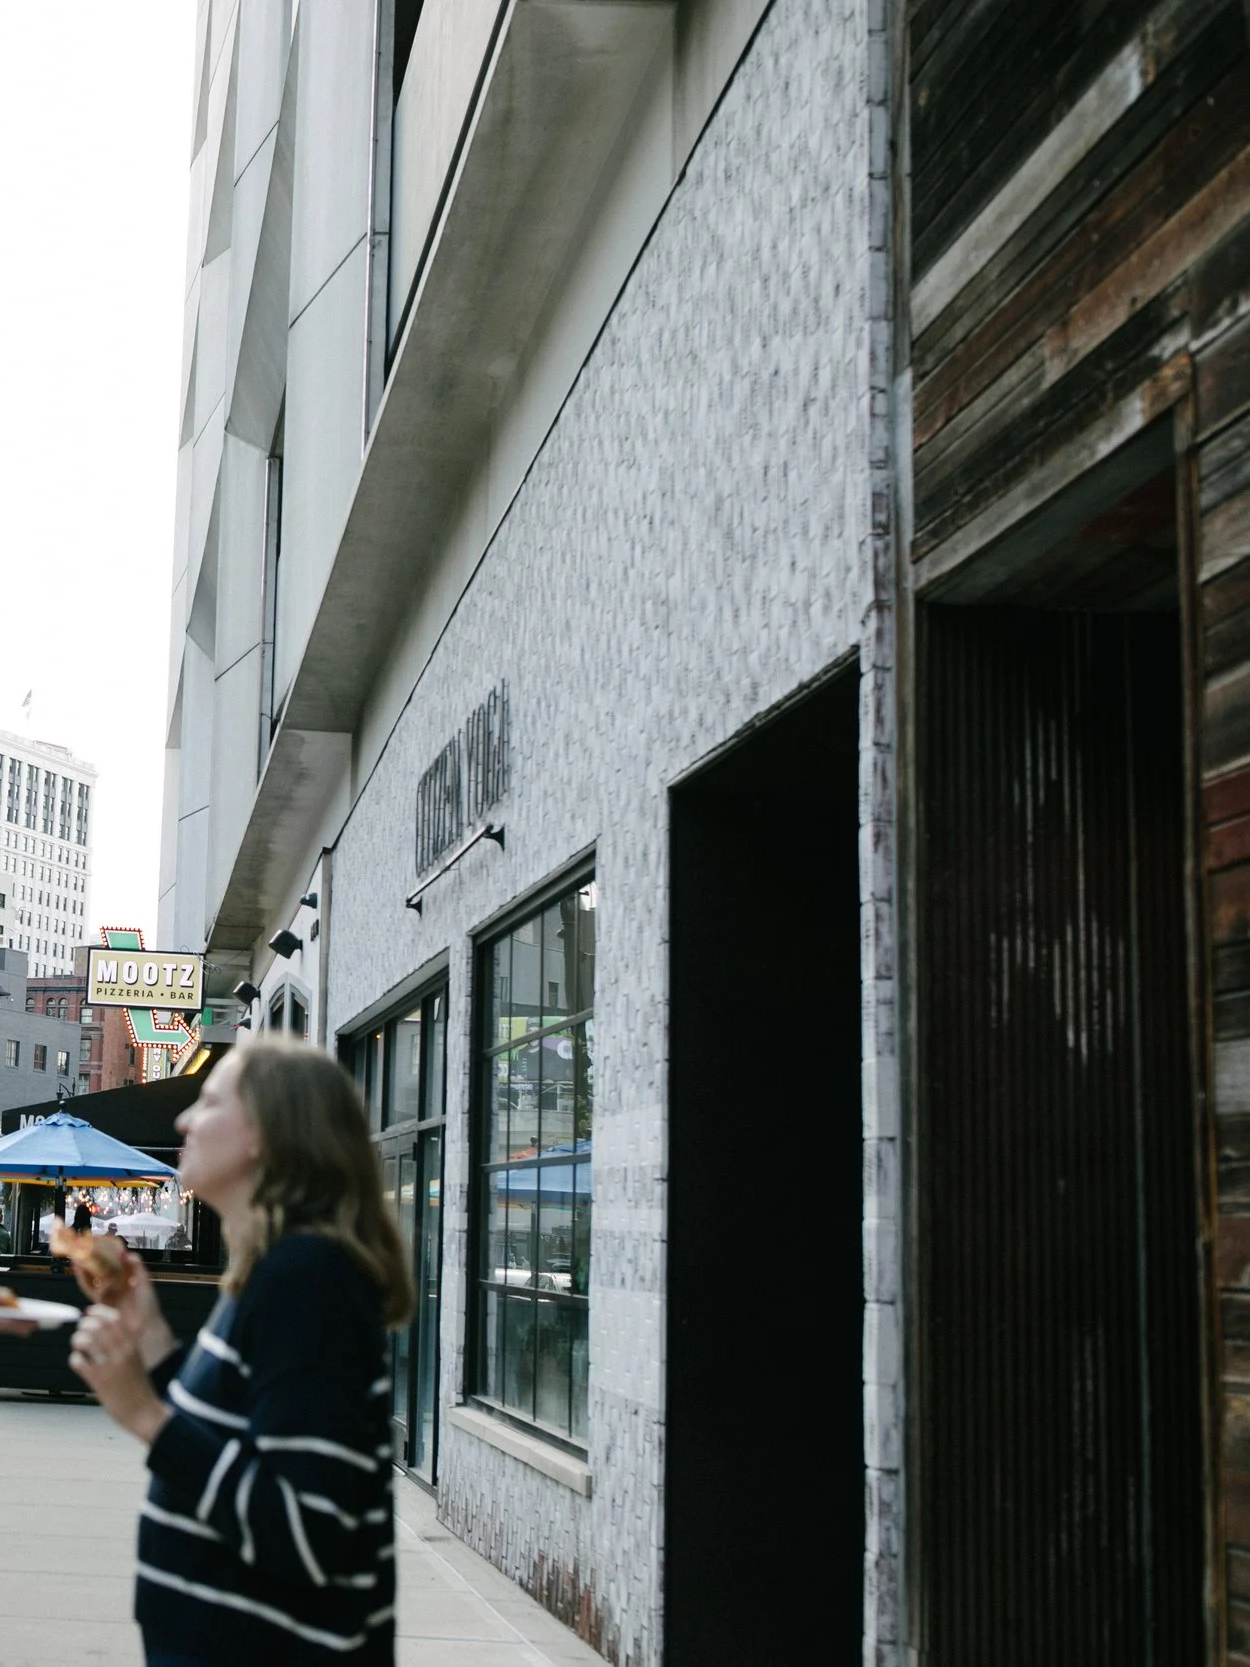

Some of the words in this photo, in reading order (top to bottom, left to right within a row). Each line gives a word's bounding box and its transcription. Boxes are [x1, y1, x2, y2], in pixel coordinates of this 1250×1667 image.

[467, 677, 510, 827] YOGA
[97, 960, 194, 988] MOOTZ
[96, 987, 154, 998] PIZZERIA
[170, 991, 194, 1001] BAR
